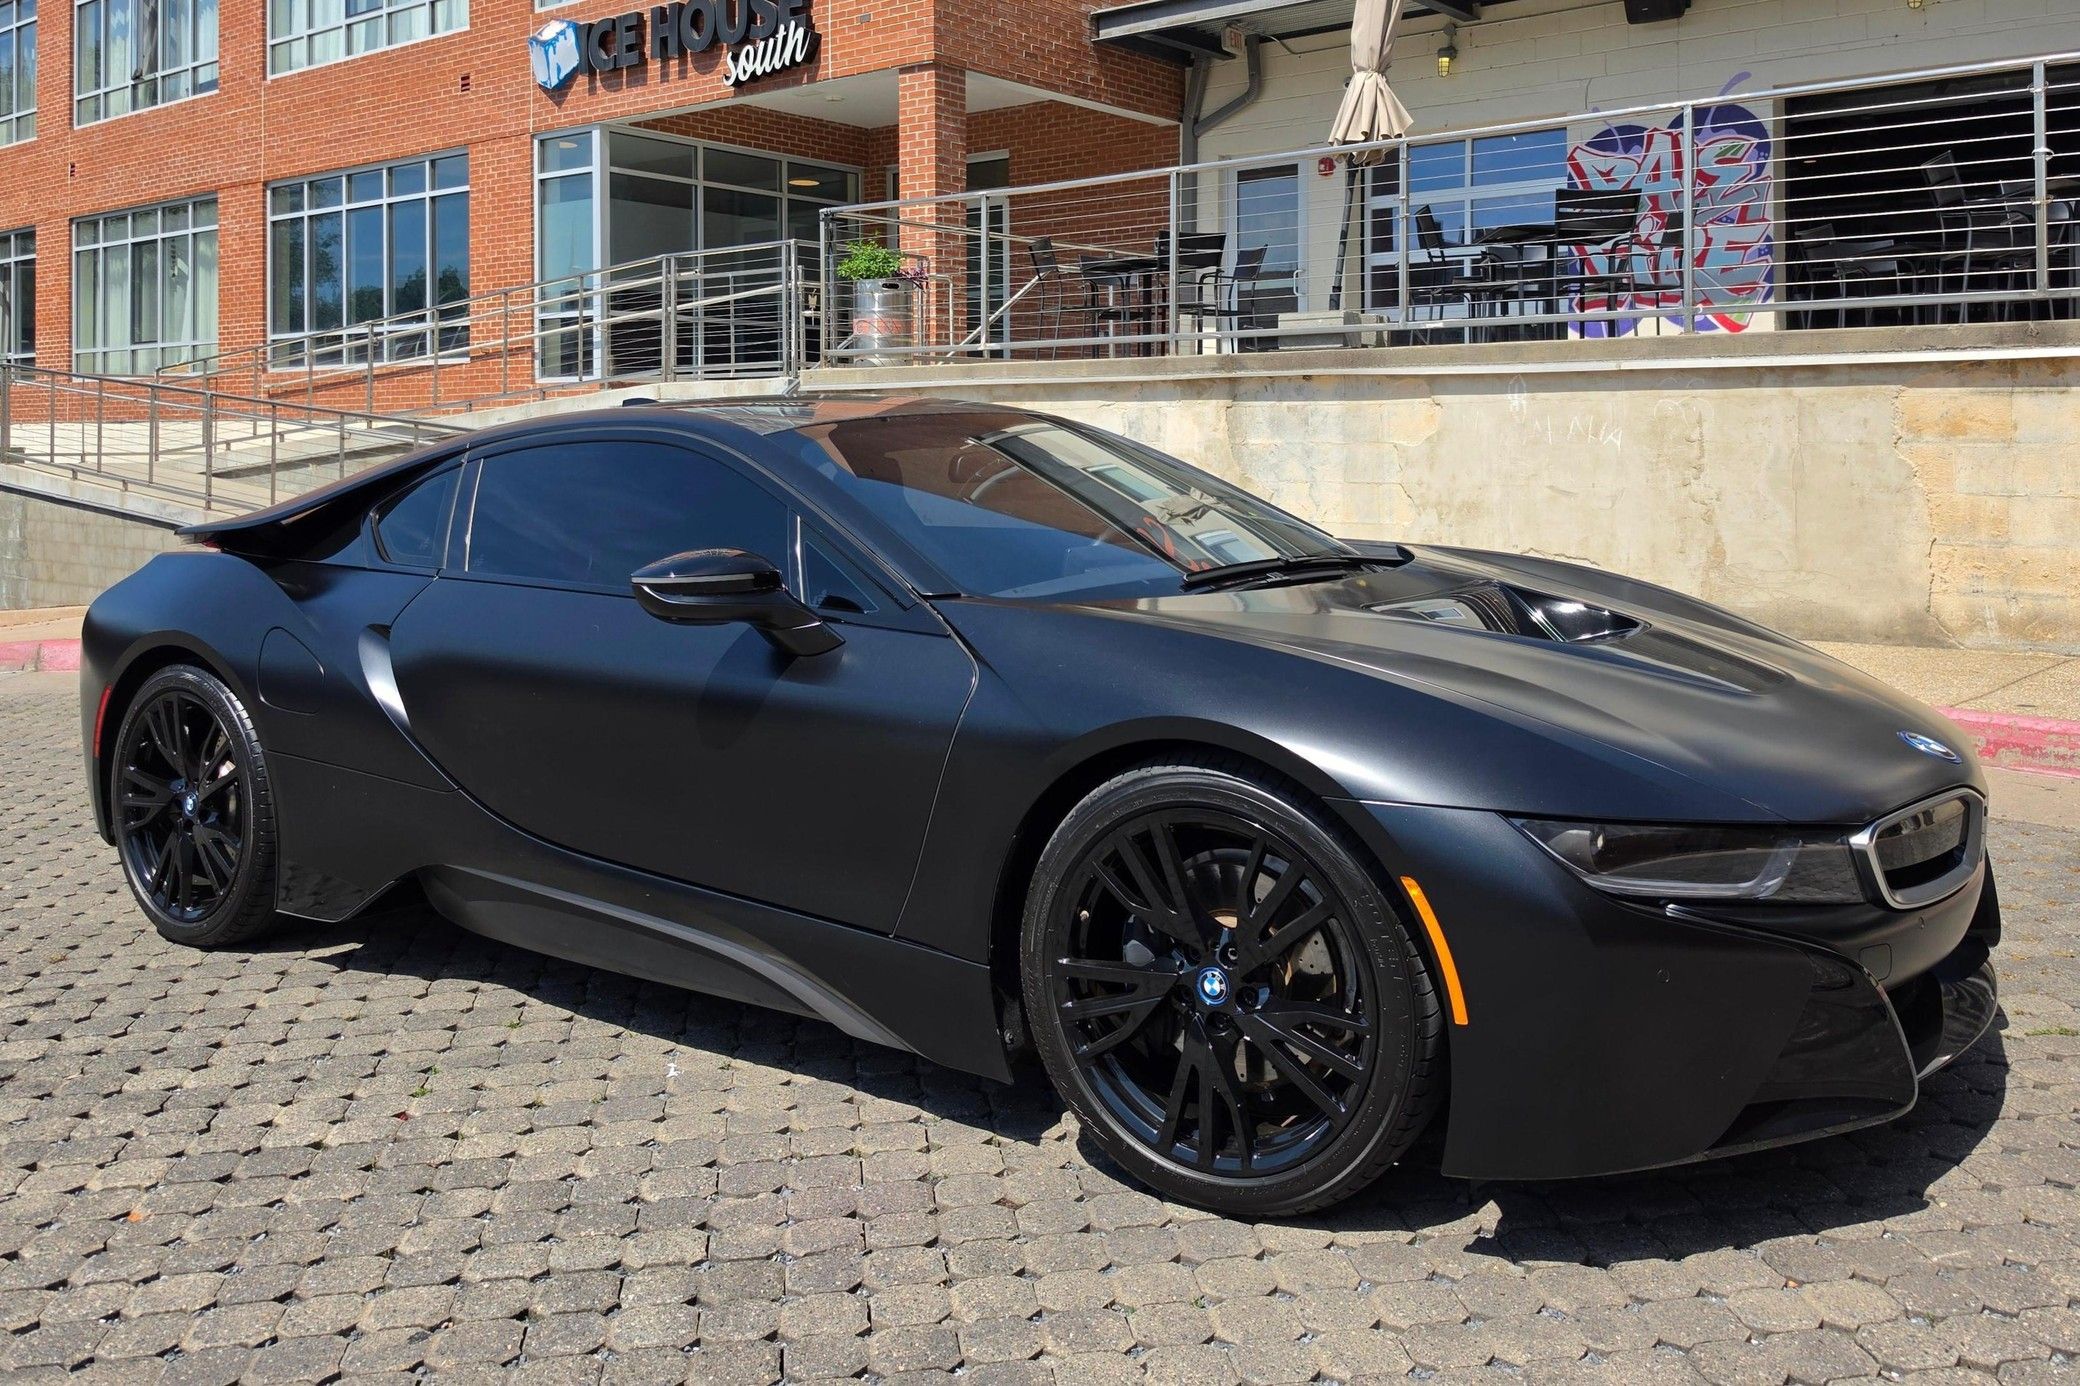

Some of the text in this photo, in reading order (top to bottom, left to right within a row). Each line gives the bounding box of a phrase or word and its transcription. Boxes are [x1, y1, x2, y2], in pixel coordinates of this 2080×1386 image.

[578, 0, 807, 75] ICE HOUSE
[722, 20, 812, 86] south
